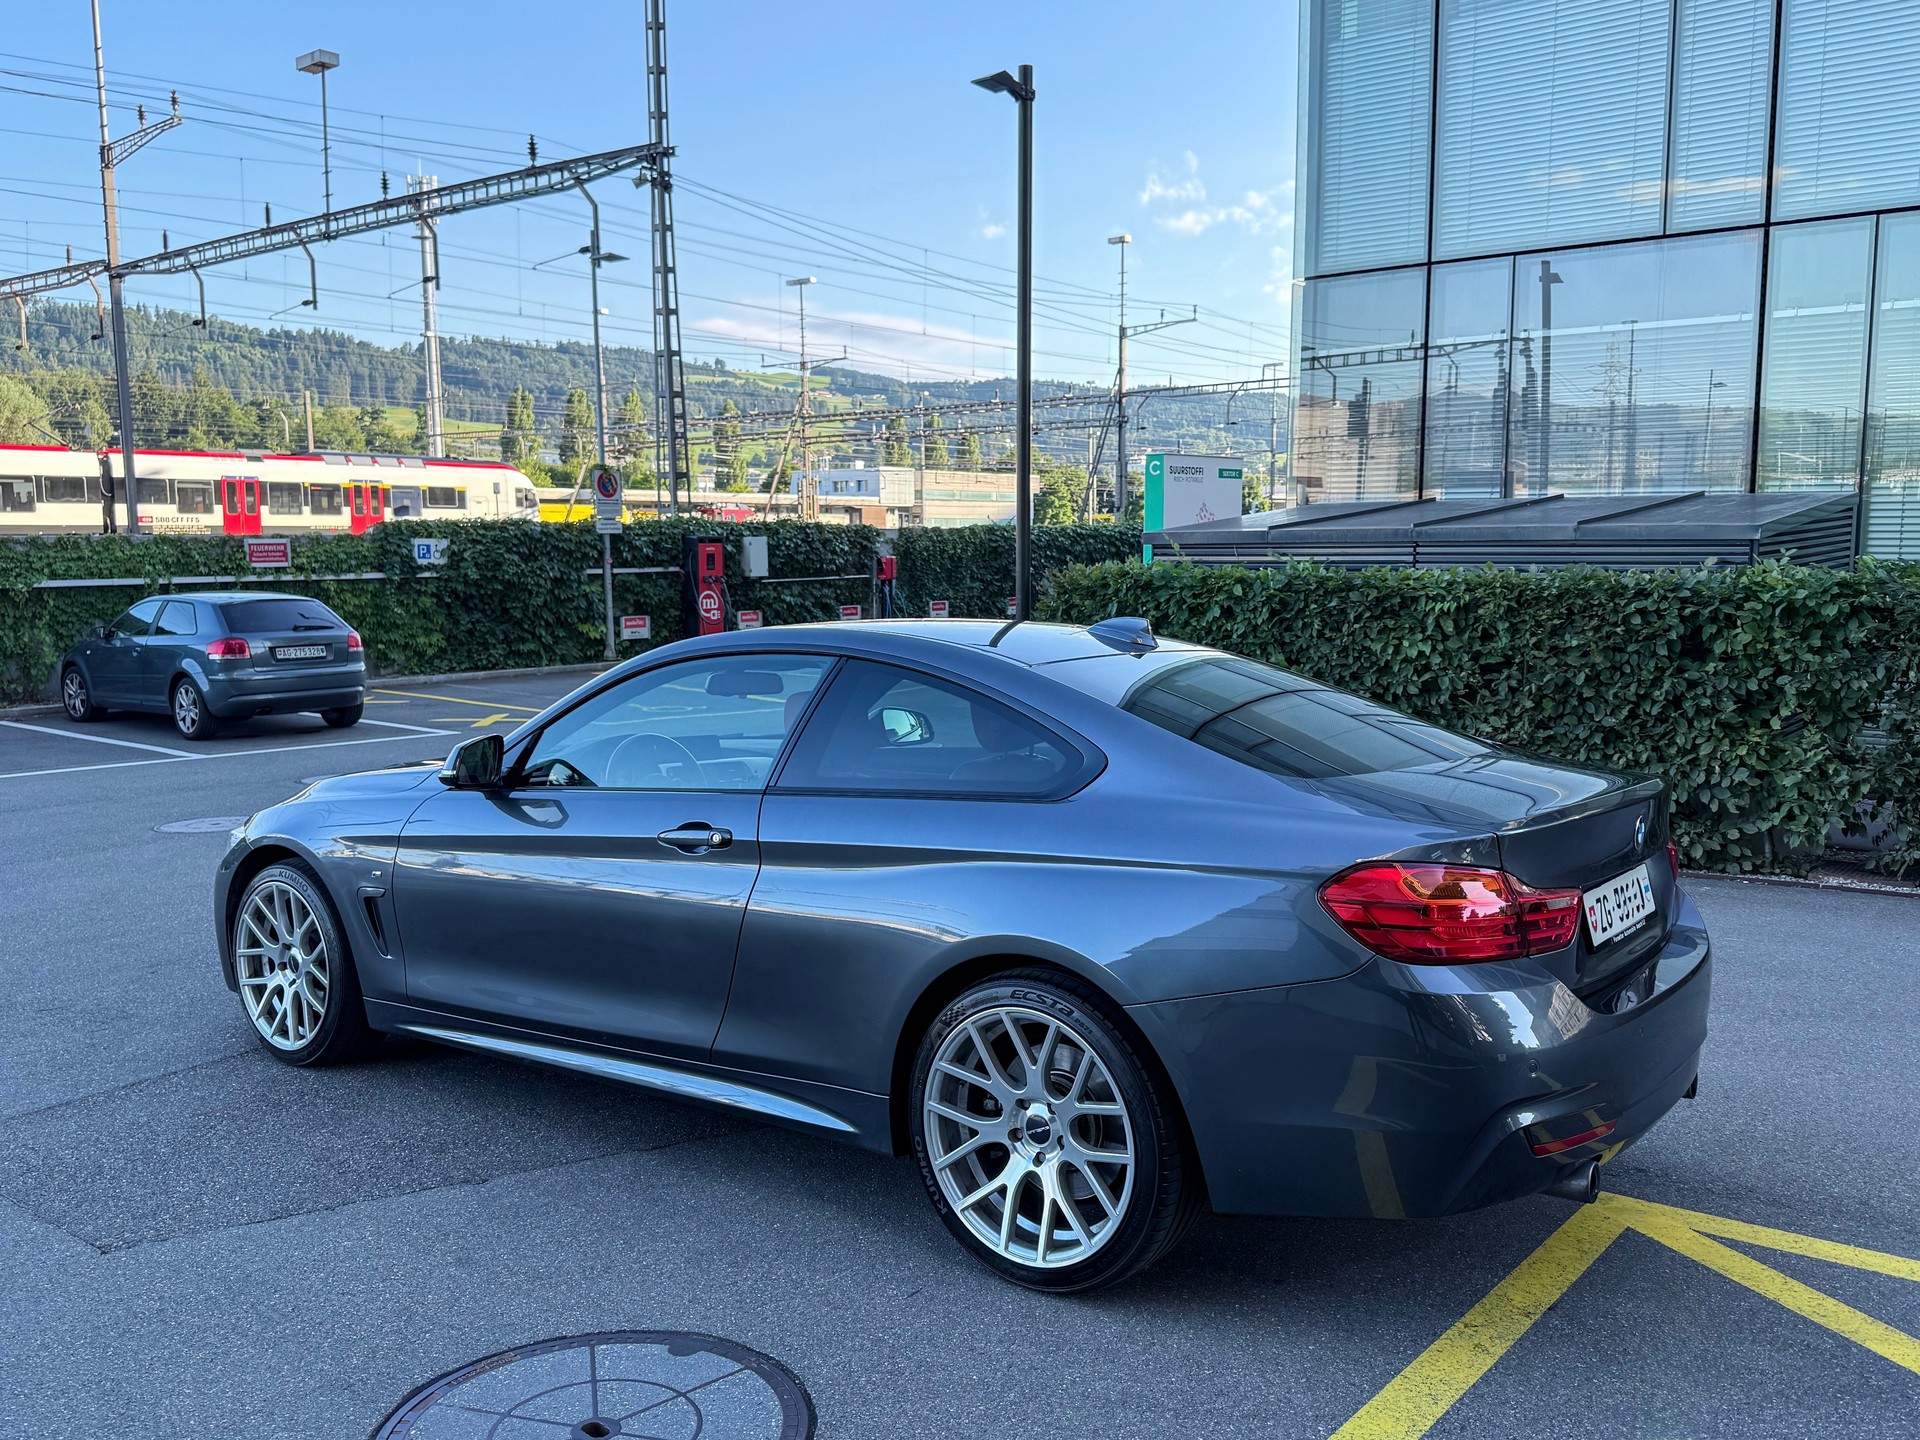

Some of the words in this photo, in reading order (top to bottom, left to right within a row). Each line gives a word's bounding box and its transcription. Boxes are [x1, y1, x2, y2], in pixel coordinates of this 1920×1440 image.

[1149, 461, 1161, 475] C
[1169, 465, 1204, 476] SUURSTOFFI
[420, 545, 428, 558] P
[279, 870, 308, 892] KUMHO
[1074, 1018, 1093, 1035] PS71
[914, 1135, 948, 1215] KUMHO
